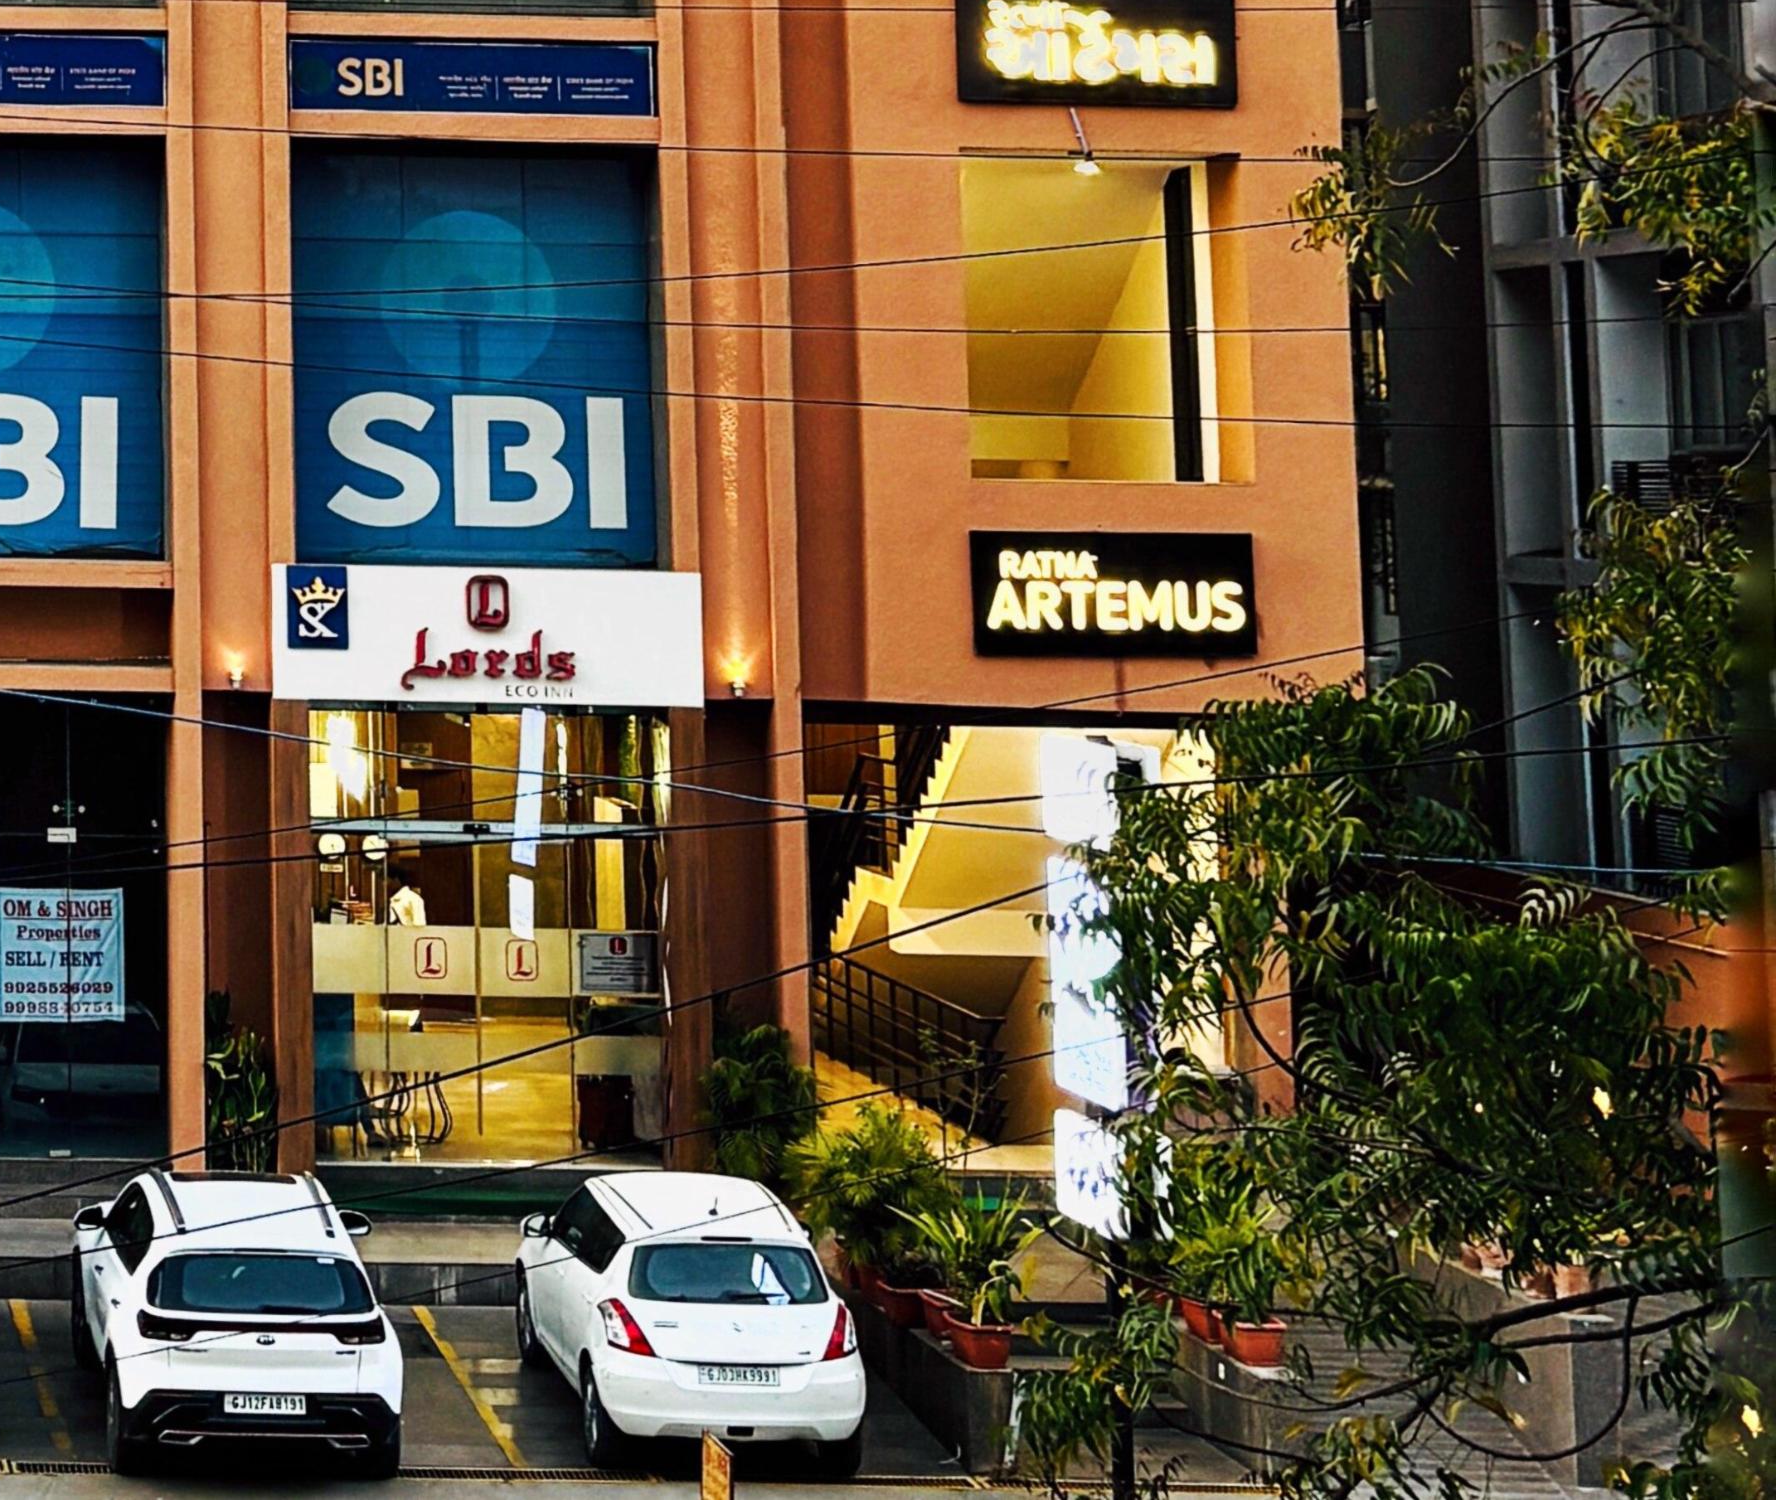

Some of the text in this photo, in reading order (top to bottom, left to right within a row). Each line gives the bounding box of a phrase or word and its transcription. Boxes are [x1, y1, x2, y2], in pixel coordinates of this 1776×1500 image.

[337, 57, 404, 96] SBI
[326, 391, 628, 530] SBI
[998, 550, 1098, 580] RATNA
[986, 580, 1246, 633] ARTEMUS
[401, 627, 576, 691] Lords
[505, 685, 574, 698] ECO INN
[3, 899, 113, 917] OM & SINGH
[5, 951, 46, 967] SELL
[59, 952, 104, 967] RENT
